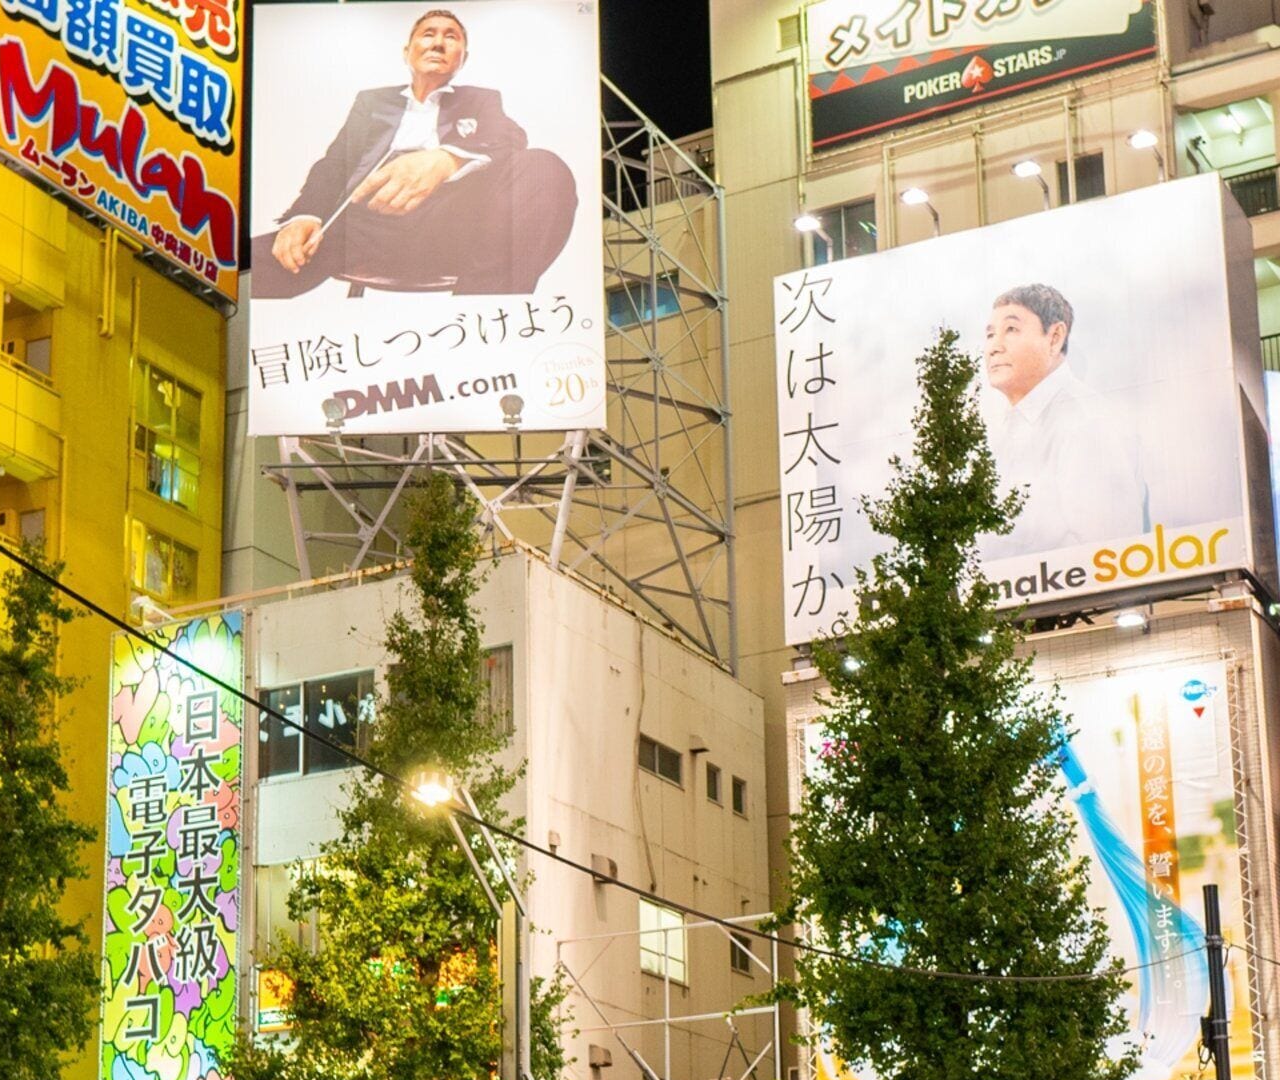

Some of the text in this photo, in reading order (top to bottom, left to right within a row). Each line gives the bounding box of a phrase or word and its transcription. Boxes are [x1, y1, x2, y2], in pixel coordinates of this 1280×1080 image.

[904, 73, 962, 104] POKER
[21, 138, 220, 283] ムーラン AKIBA 中央通り店
[251, 296, 595, 391] 冒険しつづけよう。
[544, 372, 599, 407] 20th
[1093, 525, 1230, 584] solar
[175, 690, 222, 982] 日本最大級
[122, 775, 170, 1042] 電子タバコ
